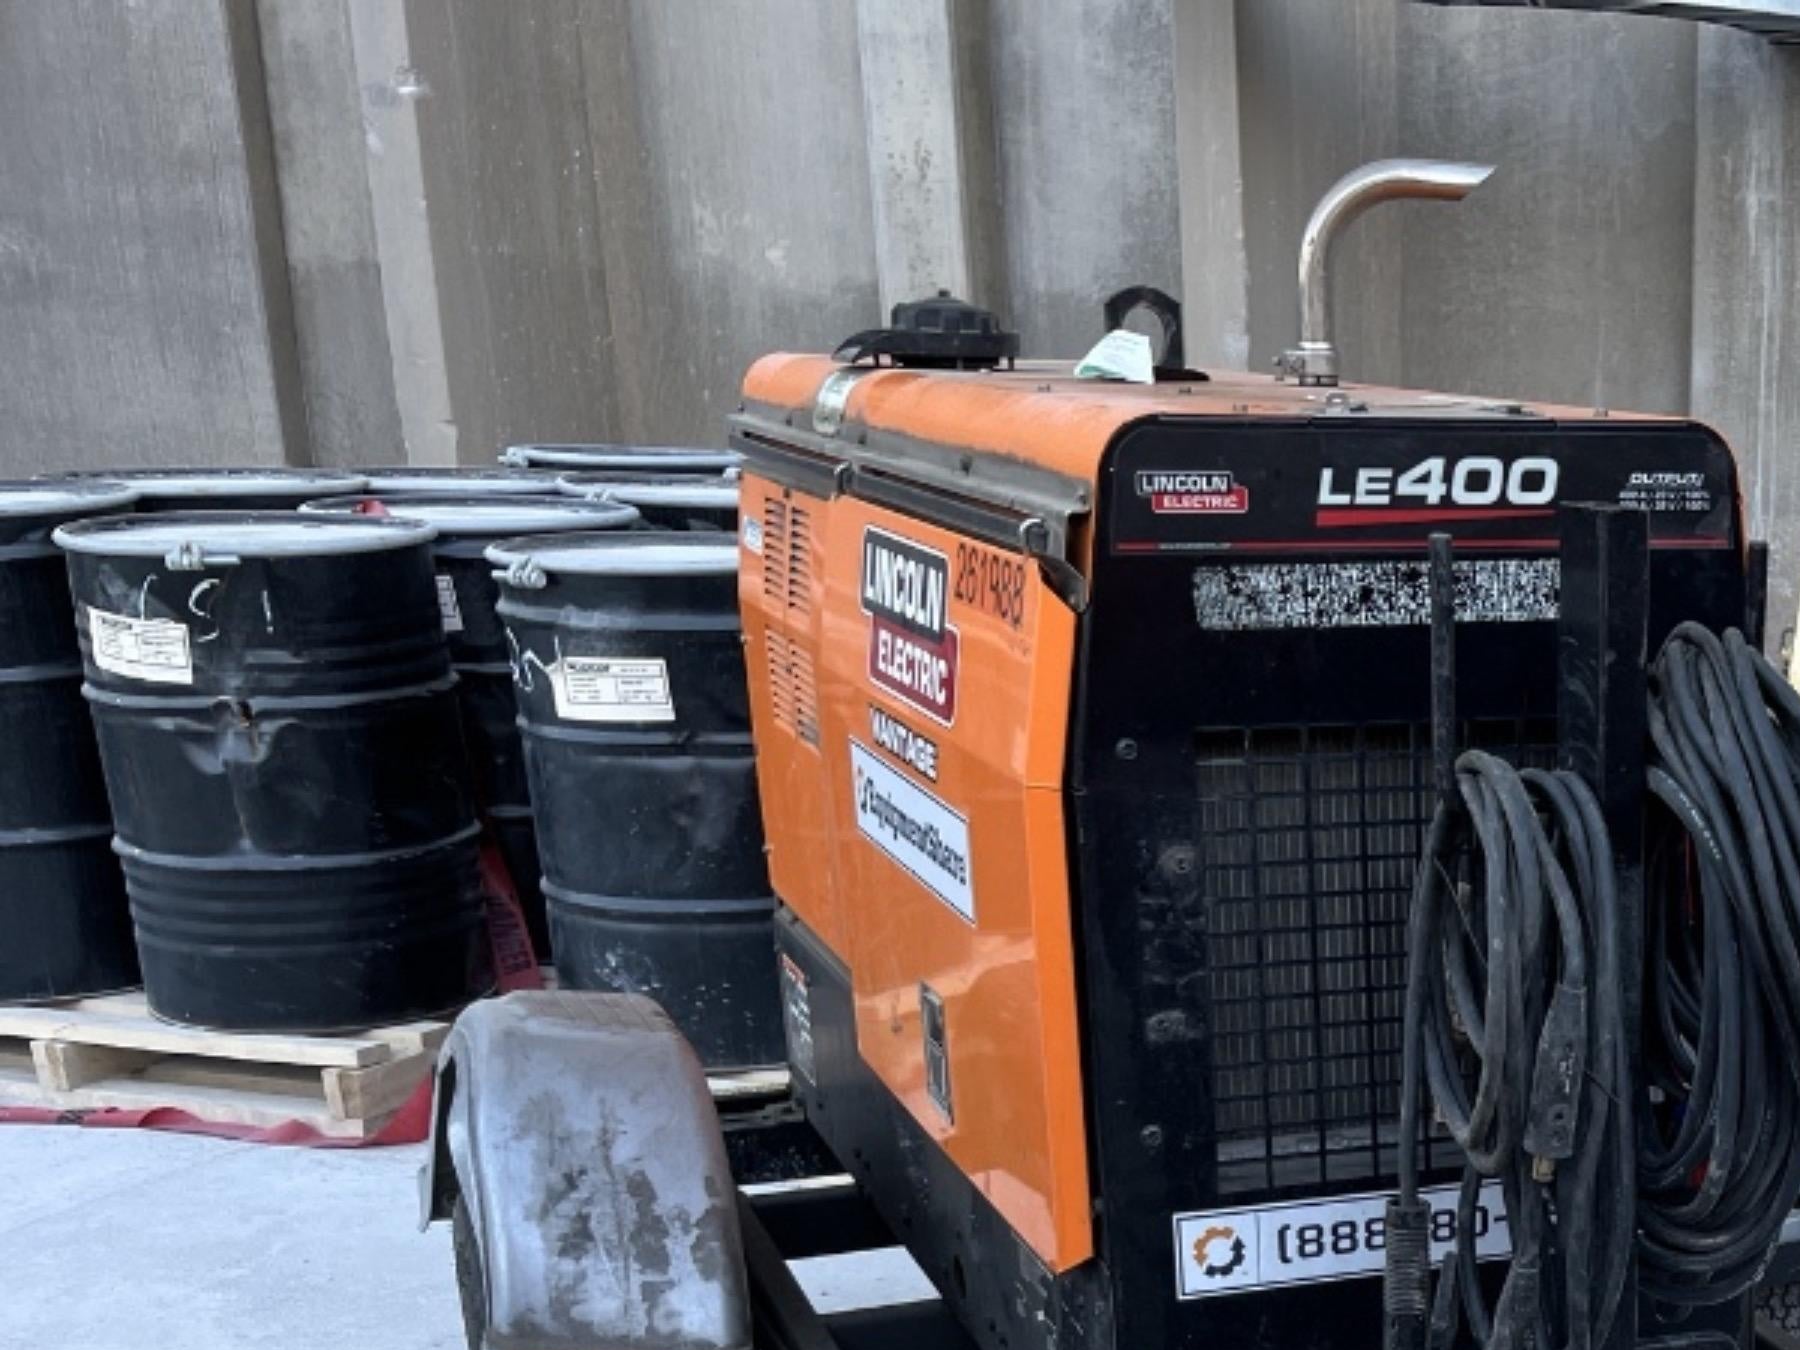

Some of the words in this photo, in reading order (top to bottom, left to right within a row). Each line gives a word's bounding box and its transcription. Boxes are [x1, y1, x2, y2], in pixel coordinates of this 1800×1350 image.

[1142, 475, 1229, 493] LINCOLN
[1163, 494, 1239, 509] ELECTRIC
[1317, 456, 1559, 506] LE400
[864, 542, 945, 633] LINCOLN
[877, 628, 949, 706] ELECTRIC
